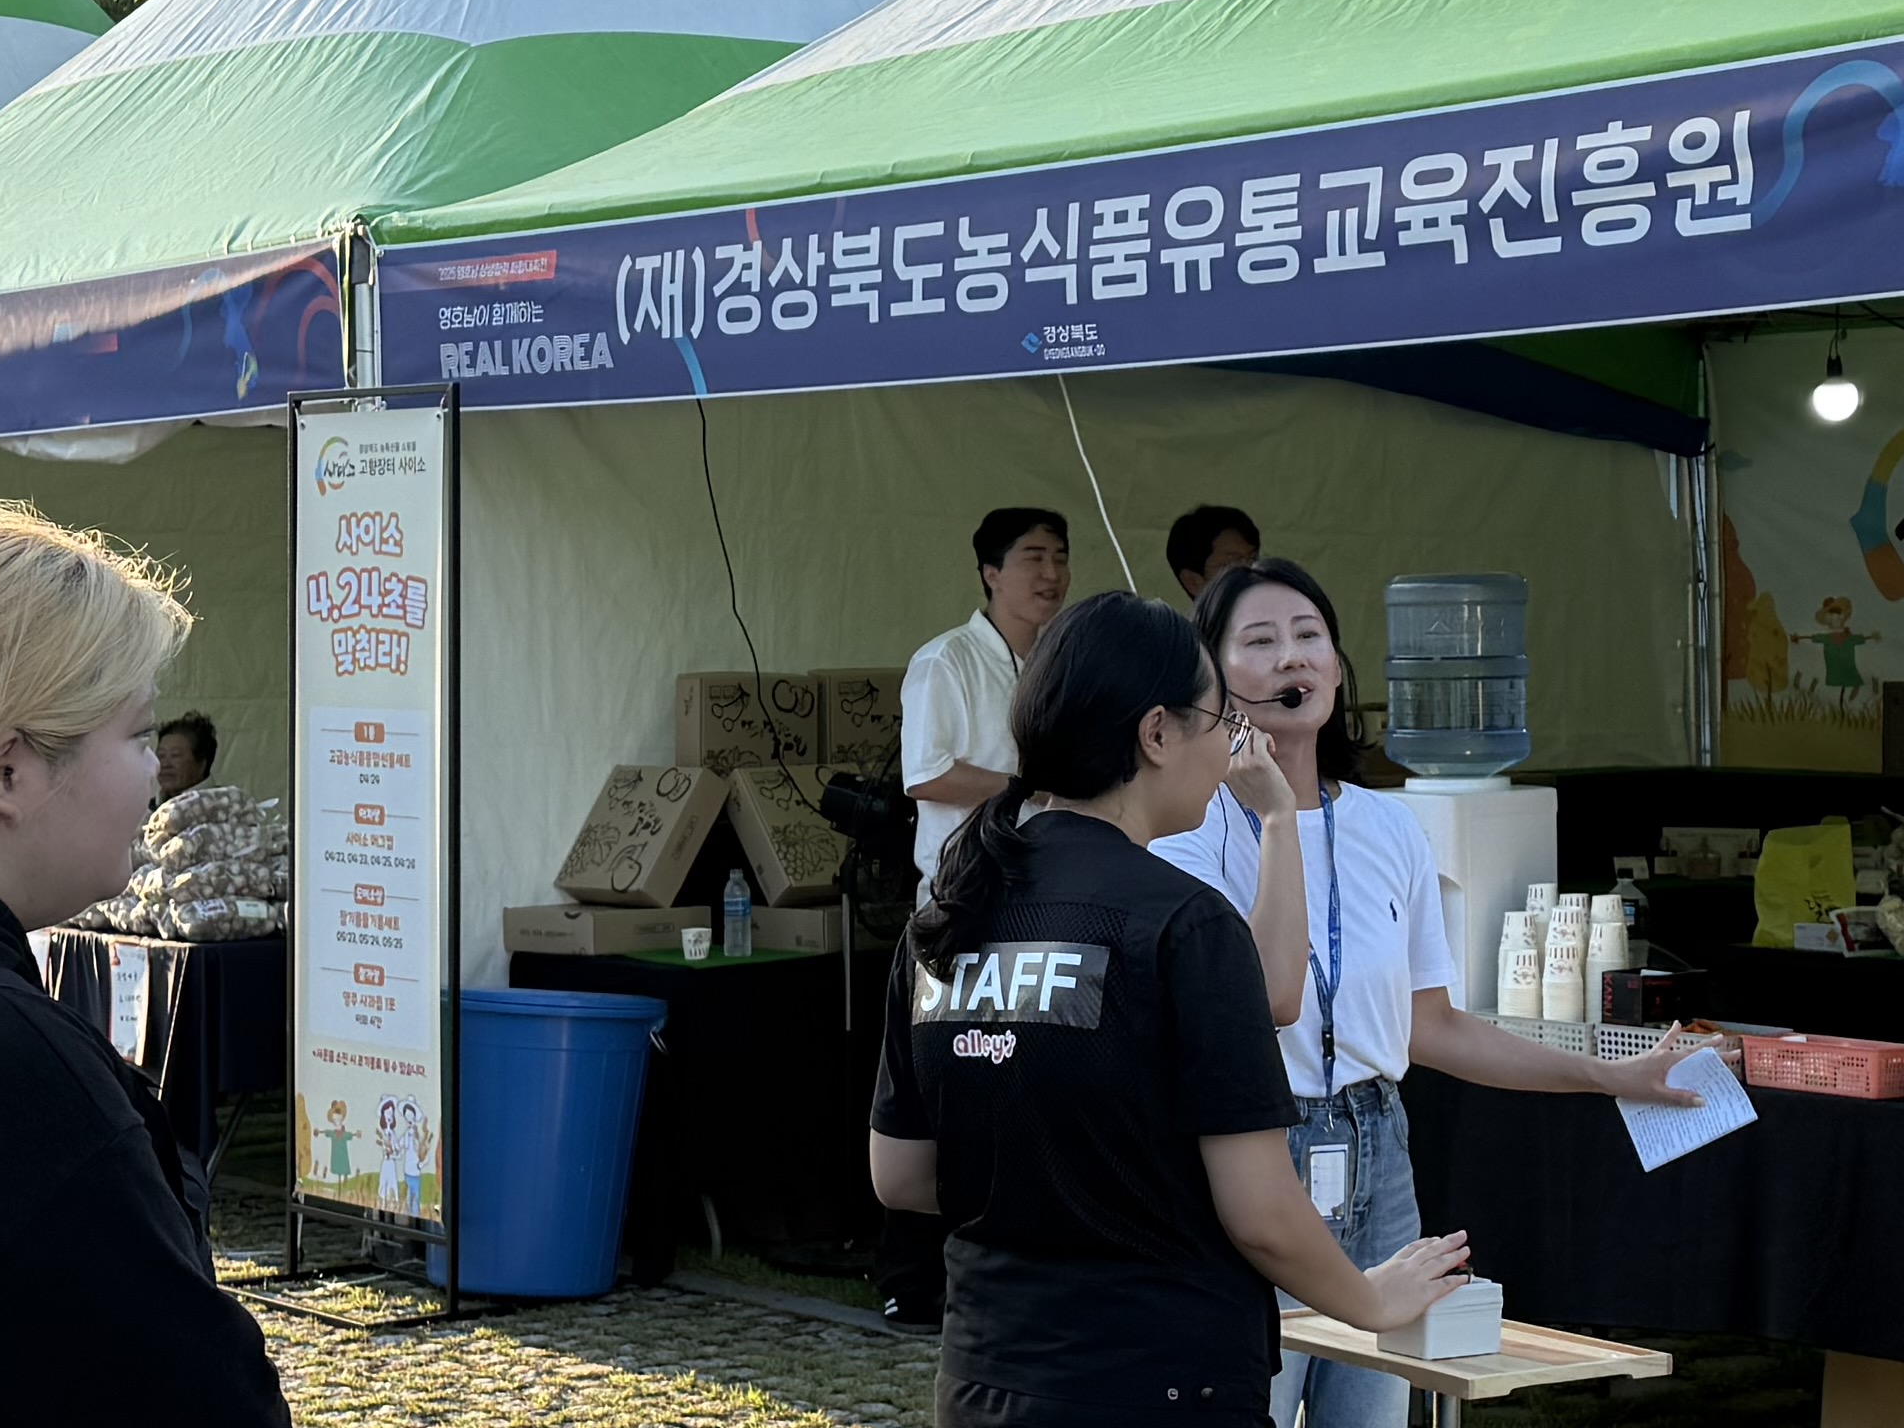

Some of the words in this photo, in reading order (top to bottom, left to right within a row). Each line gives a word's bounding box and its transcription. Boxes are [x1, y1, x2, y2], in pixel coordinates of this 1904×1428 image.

[440, 339, 510, 380] REAL
[511, 332, 614, 375] KOREA
[1043, 323, 1098, 344] 경상북도
[398, 456, 427, 475] 사이소
[337, 513, 403, 556] 사이소
[307, 568, 428, 629] 4.24초를
[332, 627, 410, 676] 맞춰라!
